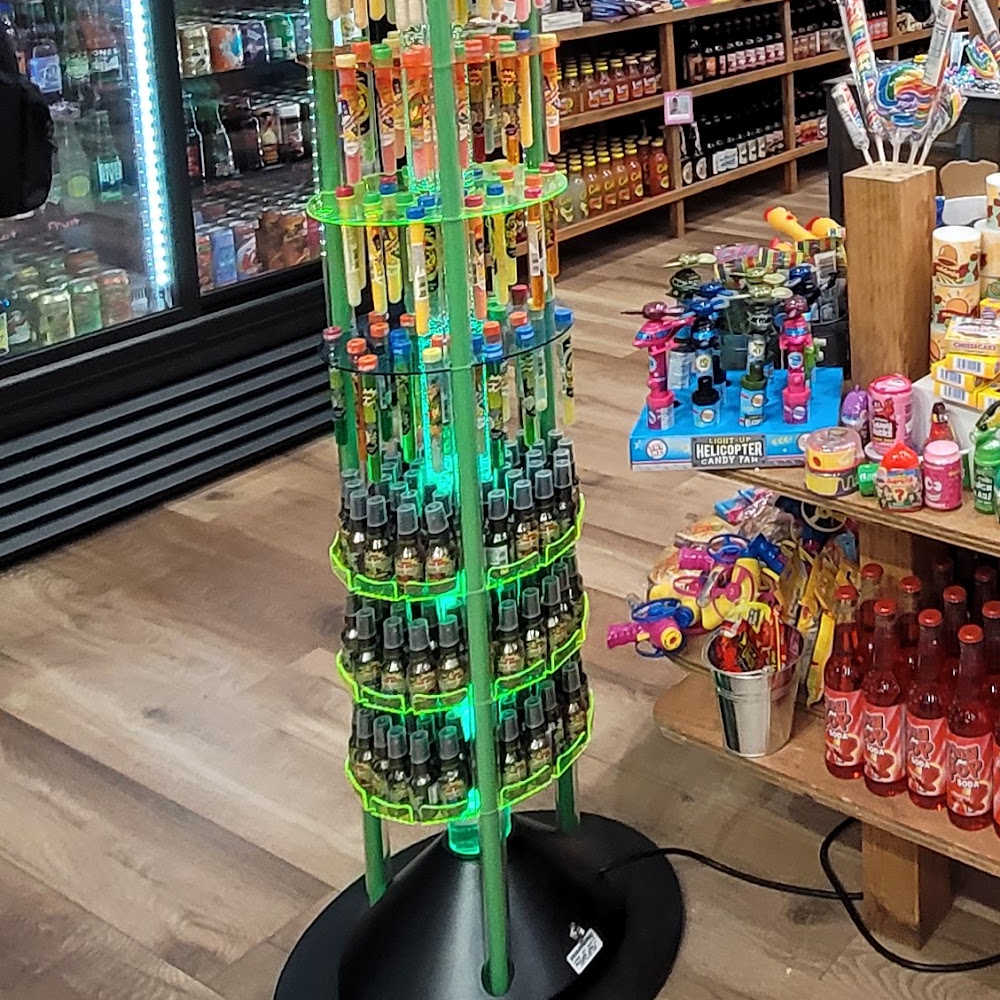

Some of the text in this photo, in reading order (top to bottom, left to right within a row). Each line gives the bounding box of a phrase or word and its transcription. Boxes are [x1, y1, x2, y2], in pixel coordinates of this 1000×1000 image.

[695, 442, 763, 459] HELICOPTER
[701, 457, 734, 465] CANDY
[828, 729, 848, 741] SODA
[866, 745, 885, 757] SODA
[910, 758, 930, 769] SODA
[957, 779, 980, 788] SODA
